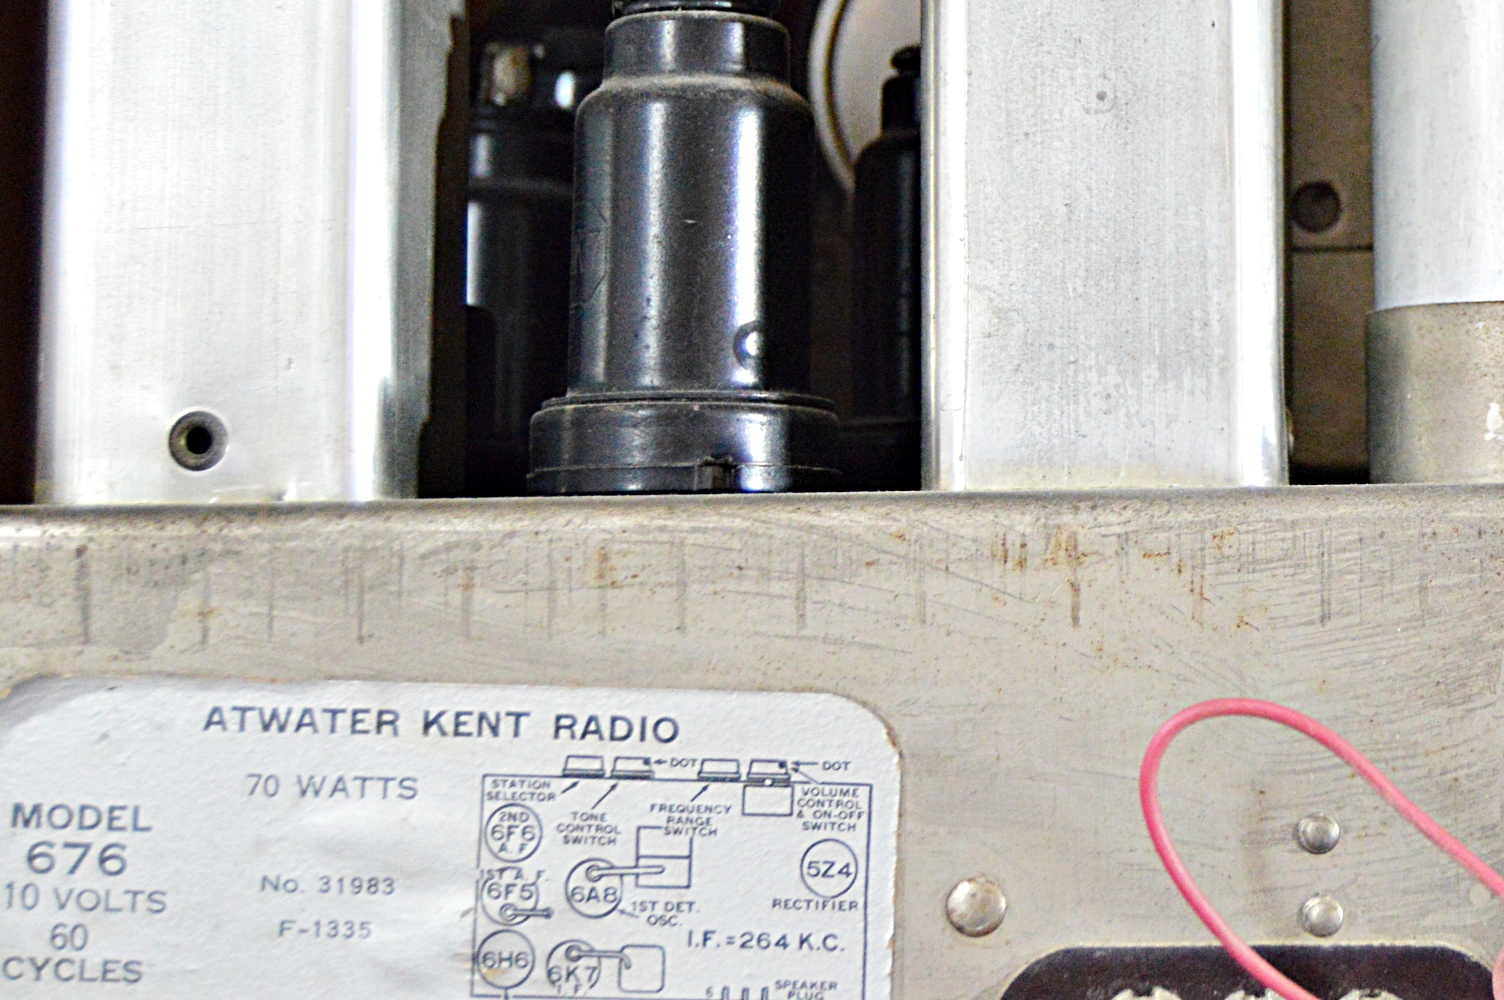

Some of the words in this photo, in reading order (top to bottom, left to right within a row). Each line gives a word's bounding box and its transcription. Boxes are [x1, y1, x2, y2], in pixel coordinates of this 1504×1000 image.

[203, 706, 400, 738] ATWATER
[422, 710, 530, 738] KENT
[552, 713, 680, 743] RADIO
[670, 757, 697, 768] DOT
[822, 761, 851, 771] DOT
[246, 774, 280, 798] 70
[297, 775, 419, 800] WATTS
[491, 779, 551, 790] STATION
[486, 791, 556, 802] SELECTOR
[801, 788, 860, 798] VOLUME
[650, 803, 732, 815] FREQUENCY
[797, 799, 863, 811] CONTROL
[11, 803, 153, 832] MODEL
[499, 811, 530, 823] 2ND
[571, 811, 607, 823] TONE
[666, 816, 713, 827] RANGE
[813, 811, 865, 821] ON-OFF
[491, 824, 537, 842] 6F6
[556, 823, 621, 836] CONTROL
[664, 827, 718, 838] SWITCH
[802, 822, 857, 833] SWITCH
[562, 835, 617, 847] SWITCH
[26, 841, 128, 877] 676
[806, 861, 853, 879] 5Z4
[317, 876, 396, 896] 31983
[487, 882, 534, 900] 6F5
[54, 888, 168, 914] VOLTS
[570, 886, 619, 904] 6A8
[632, 901, 657, 912] 1ST
[771, 898, 860, 912] RECTIFIER
[278, 919, 373, 940] F-1335
[51, 922, 88, 951] 60
[799, 932, 846, 953] K.C.
[481, 951, 530, 970] 6H6
[2, 956, 143, 984] CYCLES
[547, 965, 598, 983] 6K7
[775, 980, 838, 991] SPEAKER
[788, 990, 824, 1000] PLUG
